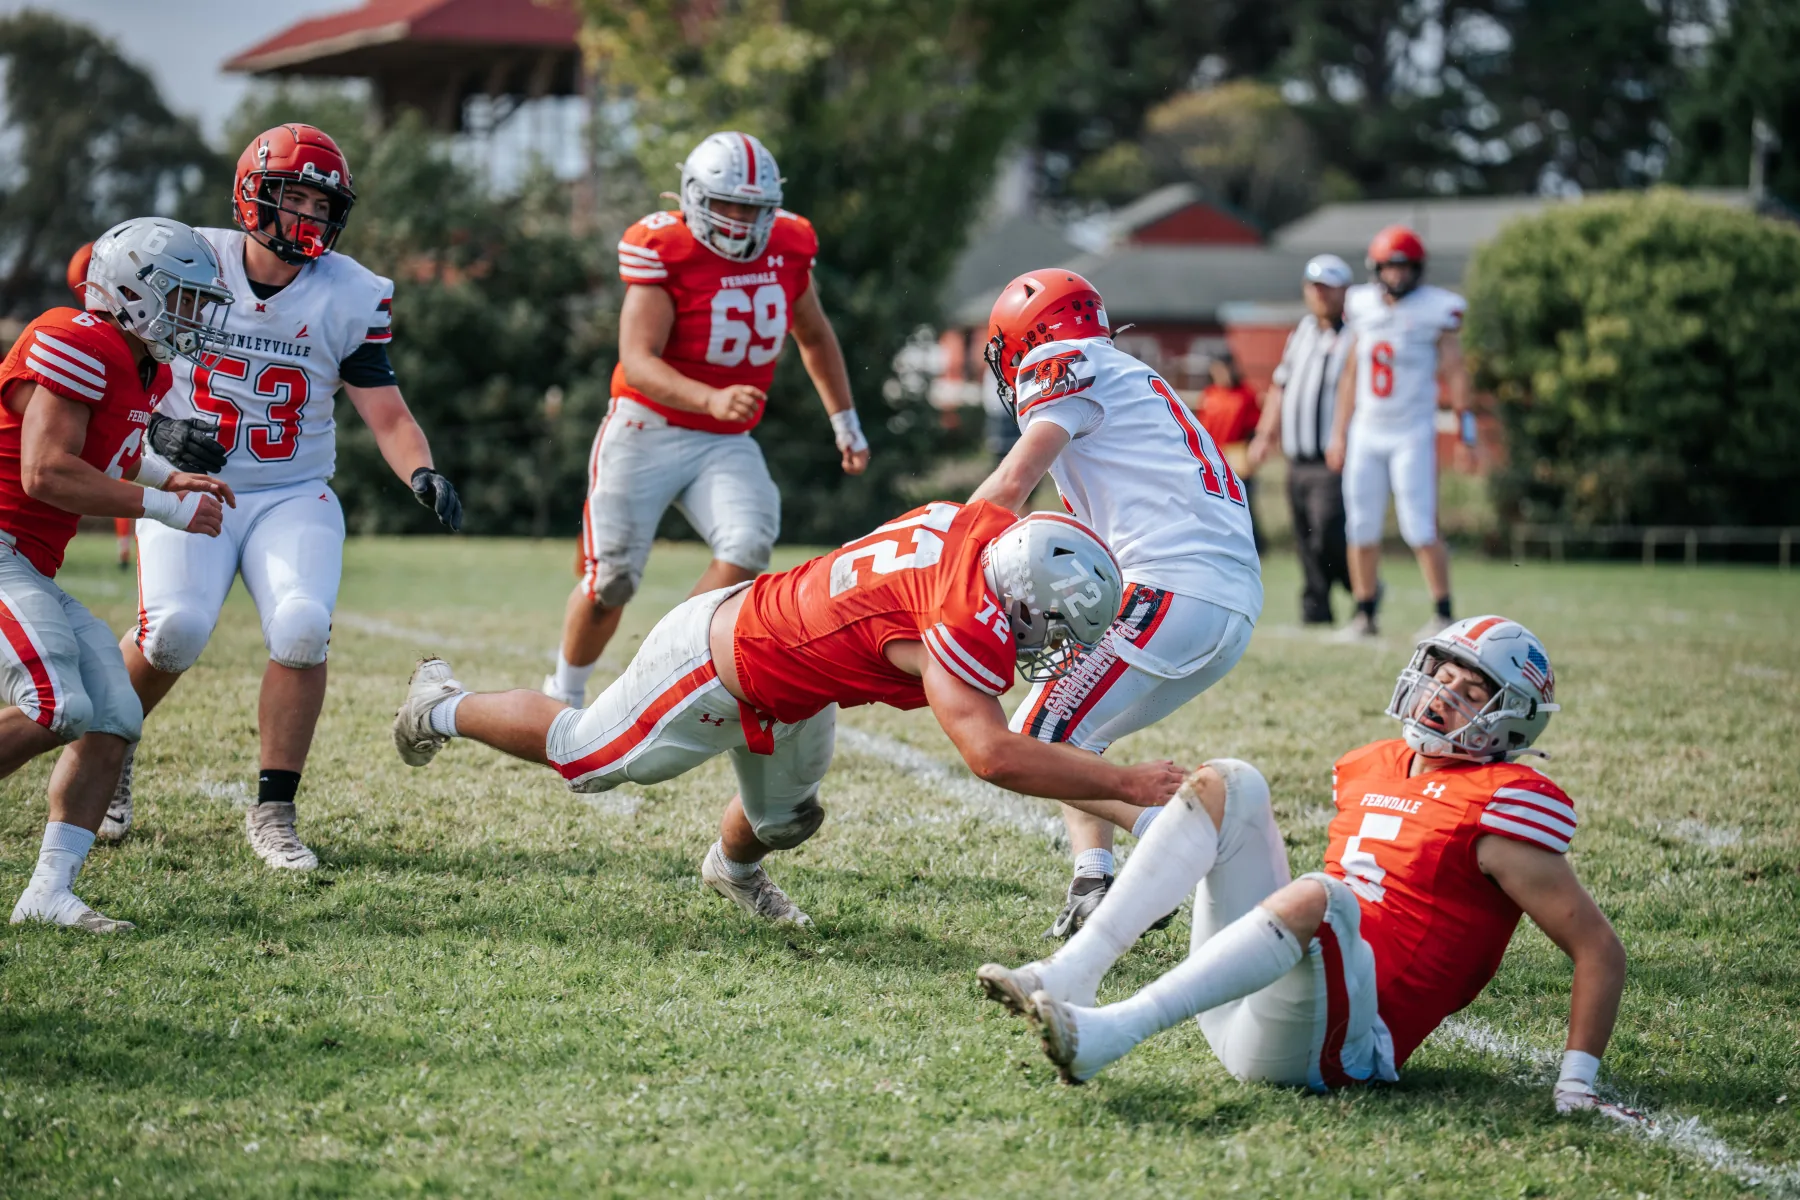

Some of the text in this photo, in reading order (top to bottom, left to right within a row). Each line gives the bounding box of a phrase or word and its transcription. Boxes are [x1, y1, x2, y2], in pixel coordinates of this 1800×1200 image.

[141, 227, 174, 256] 6
[720, 271, 777, 289] FERNDALE
[205, 329, 311, 357] INLEYVILLE
[705, 283, 787, 368] 69
[1371, 340, 1394, 398] 6
[189, 348, 311, 463] 53
[829, 502, 960, 599] 72
[1049, 558, 1102, 618] 72
[974, 594, 1011, 645] 72
[1360, 793, 1423, 814] FERNDALE
[1340, 812, 1403, 902] 5
